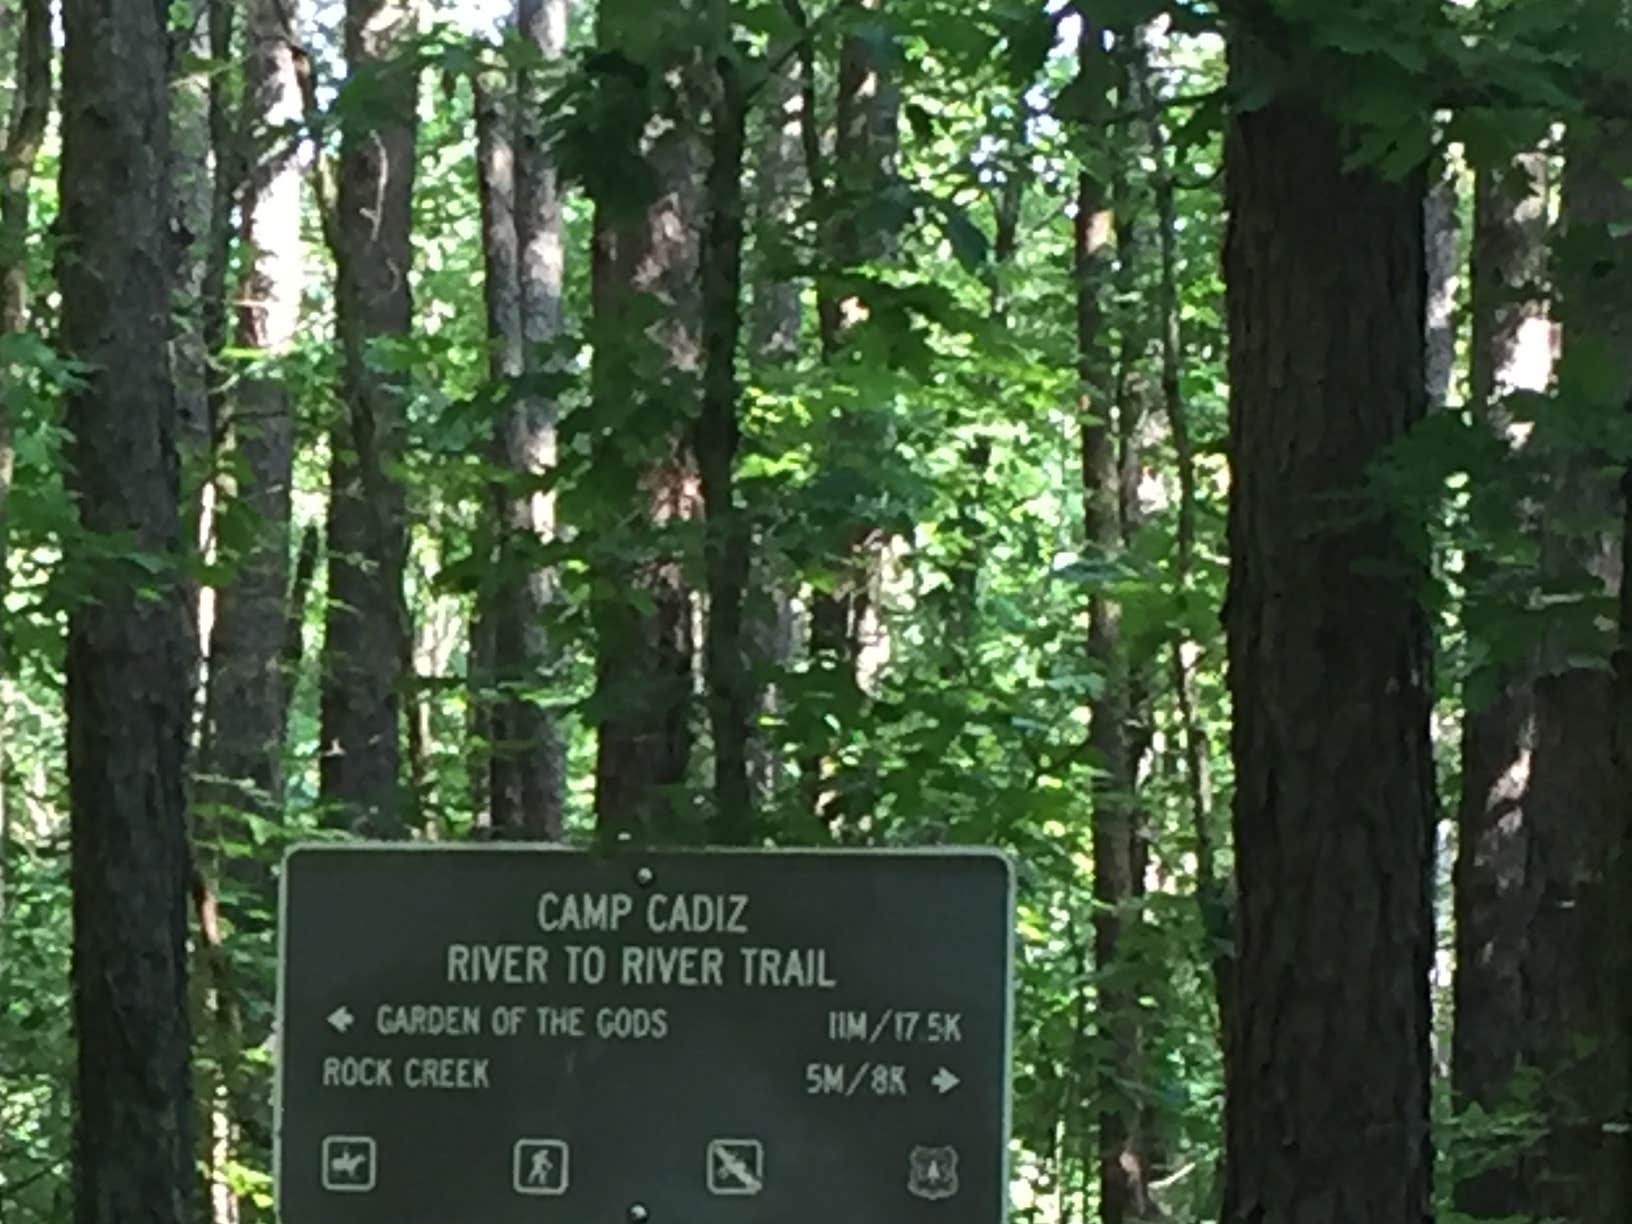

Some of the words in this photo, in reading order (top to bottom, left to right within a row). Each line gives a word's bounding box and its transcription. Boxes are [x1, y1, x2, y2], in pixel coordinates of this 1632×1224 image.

[537, 891, 632, 932] CAMP
[646, 894, 748, 933] CADIZ
[447, 945, 548, 983] RIVER
[565, 946, 605, 984] TO
[622, 946, 723, 985] RIVER
[740, 948, 837, 987] TRAIL
[376, 1005, 481, 1035] GARDEN
[491, 1006, 526, 1036] OF
[536, 1006, 585, 1037] THE
[596, 1008, 668, 1038] GODS
[322, 1057, 393, 1087] ROCK
[404, 1057, 490, 1088] CREEK
[805, 1061, 907, 1096] 5M/8K
